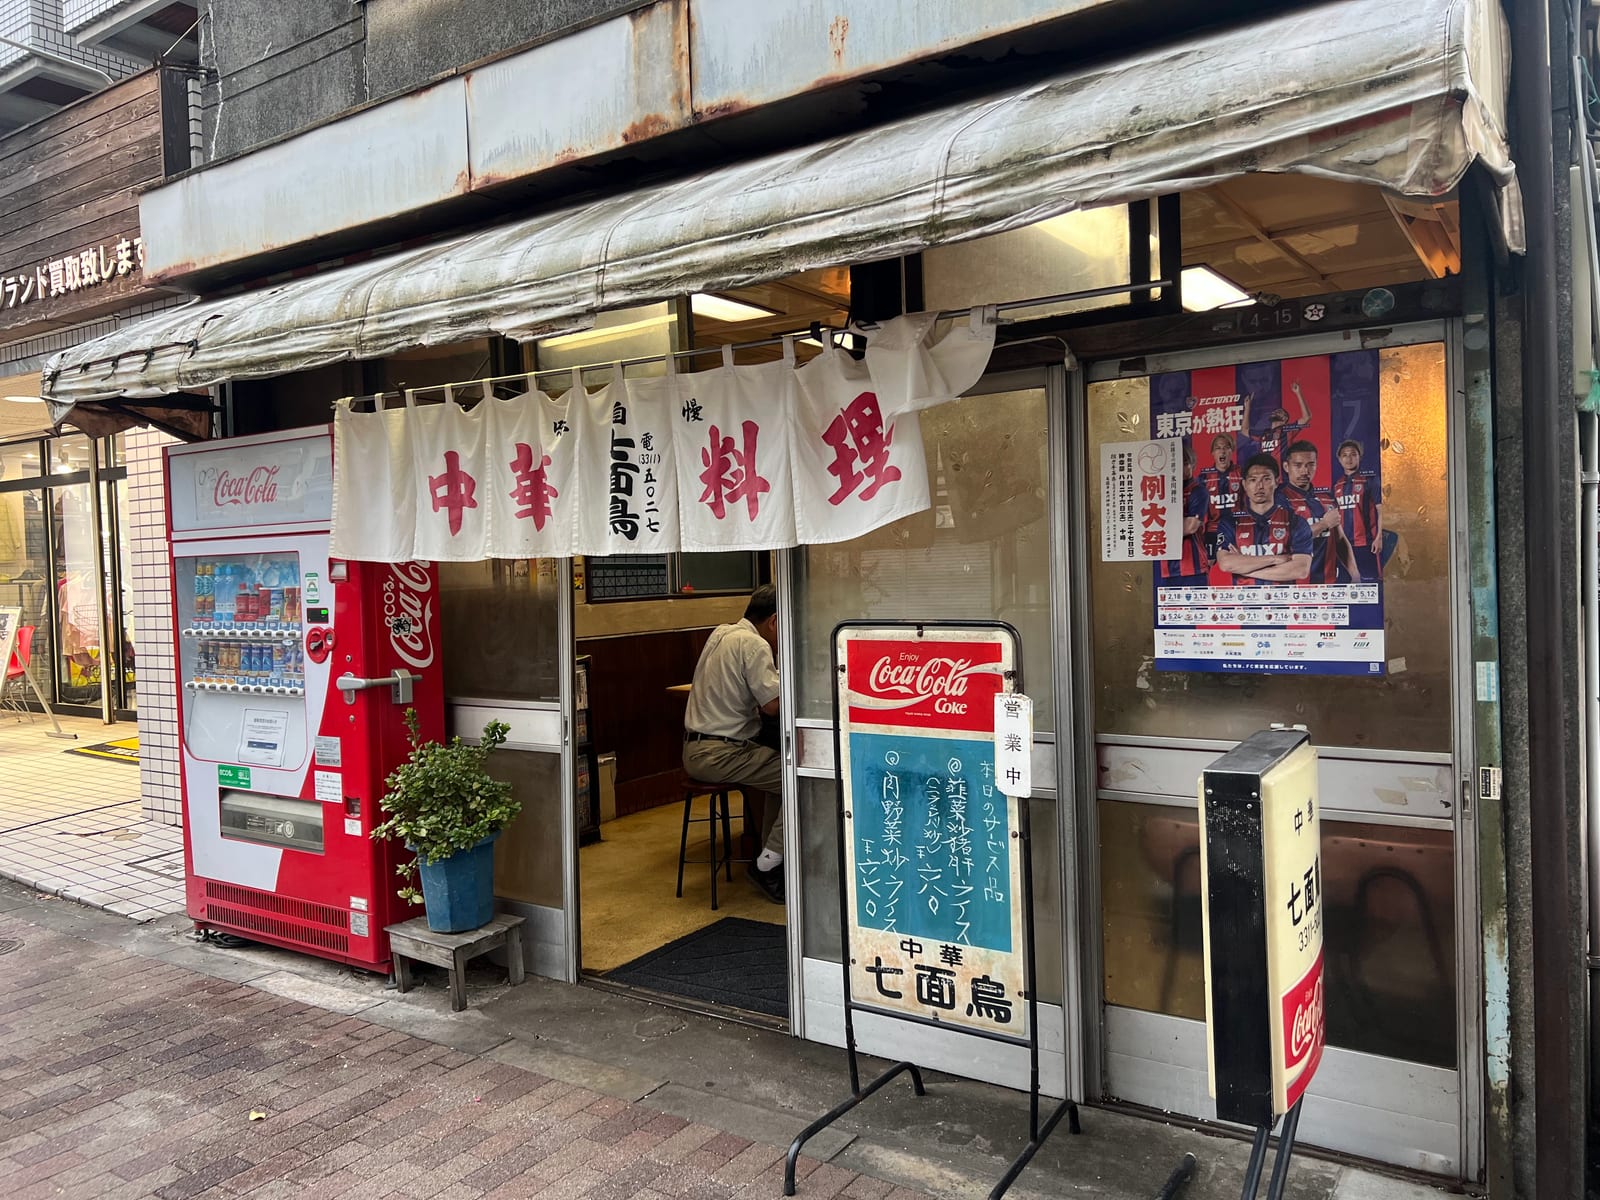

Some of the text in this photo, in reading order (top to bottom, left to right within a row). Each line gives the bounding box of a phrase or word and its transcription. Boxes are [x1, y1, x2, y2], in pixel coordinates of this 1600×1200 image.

[1156, 405, 1244, 438] 東京が熱狂
[214, 464, 280, 507] Coca-Cola
[1210, 492, 1238, 505] MIXI
[1336, 493, 1361, 505] MIXI
[1140, 474, 1167, 557] 例大祭
[1240, 543, 1284, 556] MIXI
[899, 652, 920, 662] Enjoy
[869, 656, 971, 697] Coca-Cola
[934, 698, 968, 715] Coke
[1004, 700, 1022, 785] 営業中
[1287, 853, 1320, 926] 七面
[900, 938, 964, 968] 中華
[866, 956, 1013, 1024] 七面鳥
